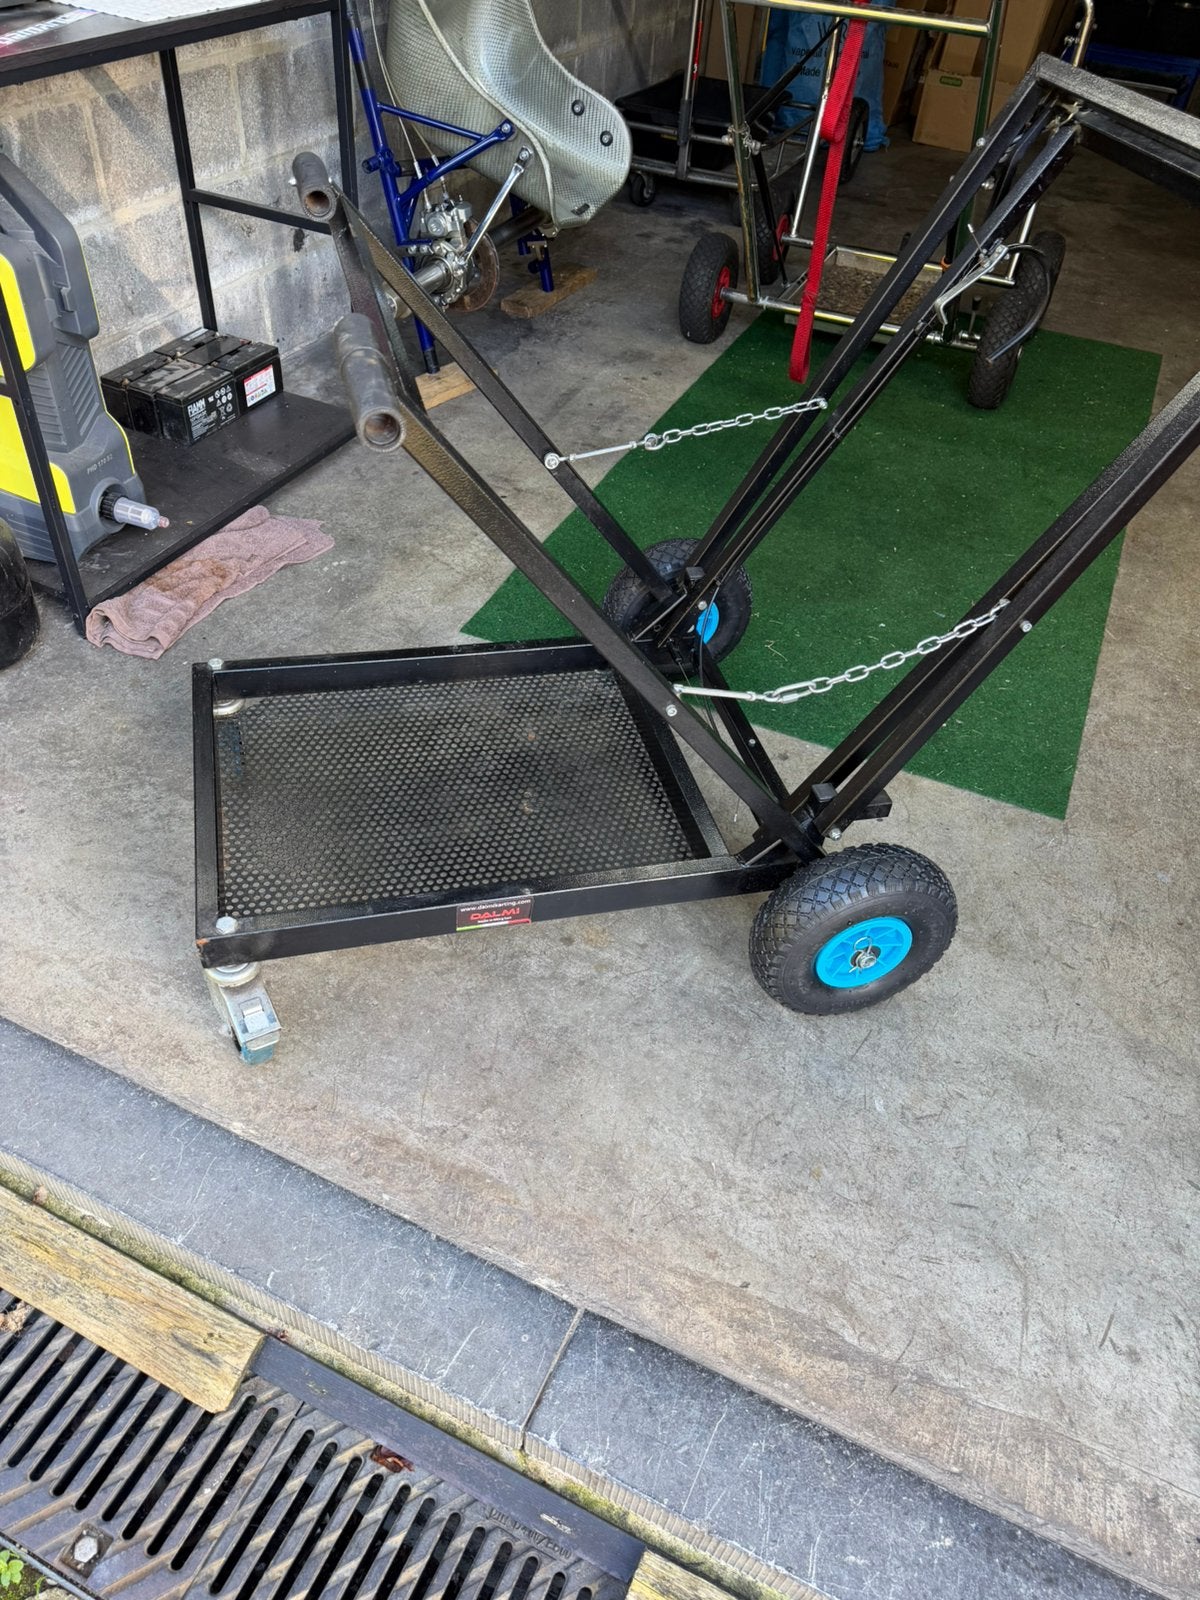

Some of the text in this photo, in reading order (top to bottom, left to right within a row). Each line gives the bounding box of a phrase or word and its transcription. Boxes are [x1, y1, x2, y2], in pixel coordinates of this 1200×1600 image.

[187, 398, 206, 416] FIAMM
[460, 899, 531, 912] www.dalmikarting.com
[470, 907, 520, 921] DALMI
